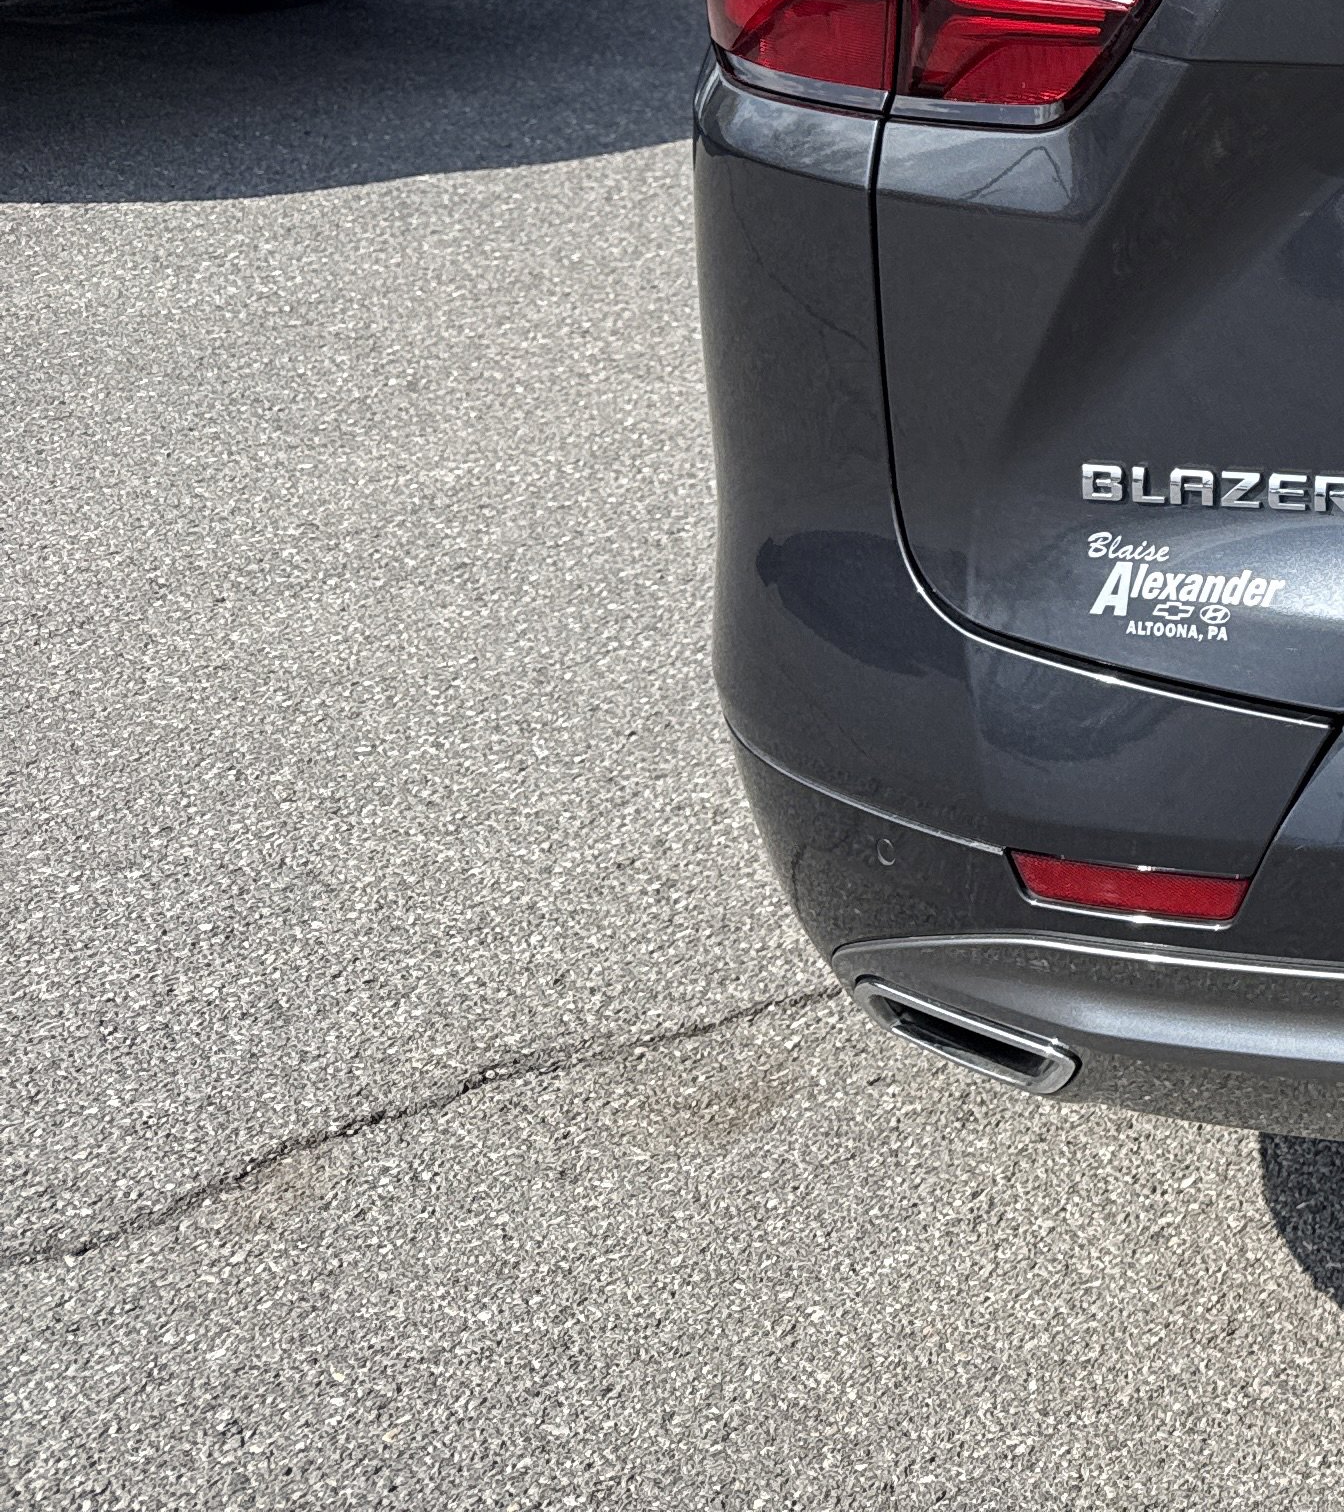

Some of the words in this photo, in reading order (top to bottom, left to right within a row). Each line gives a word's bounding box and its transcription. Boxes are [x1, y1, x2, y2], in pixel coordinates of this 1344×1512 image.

[1087, 532, 1170, 562] Blaise
[1089, 561, 1286, 617] Alexander
[1126, 620, 1203, 642] ALTOONA,
[1208, 625, 1229, 641] PA
